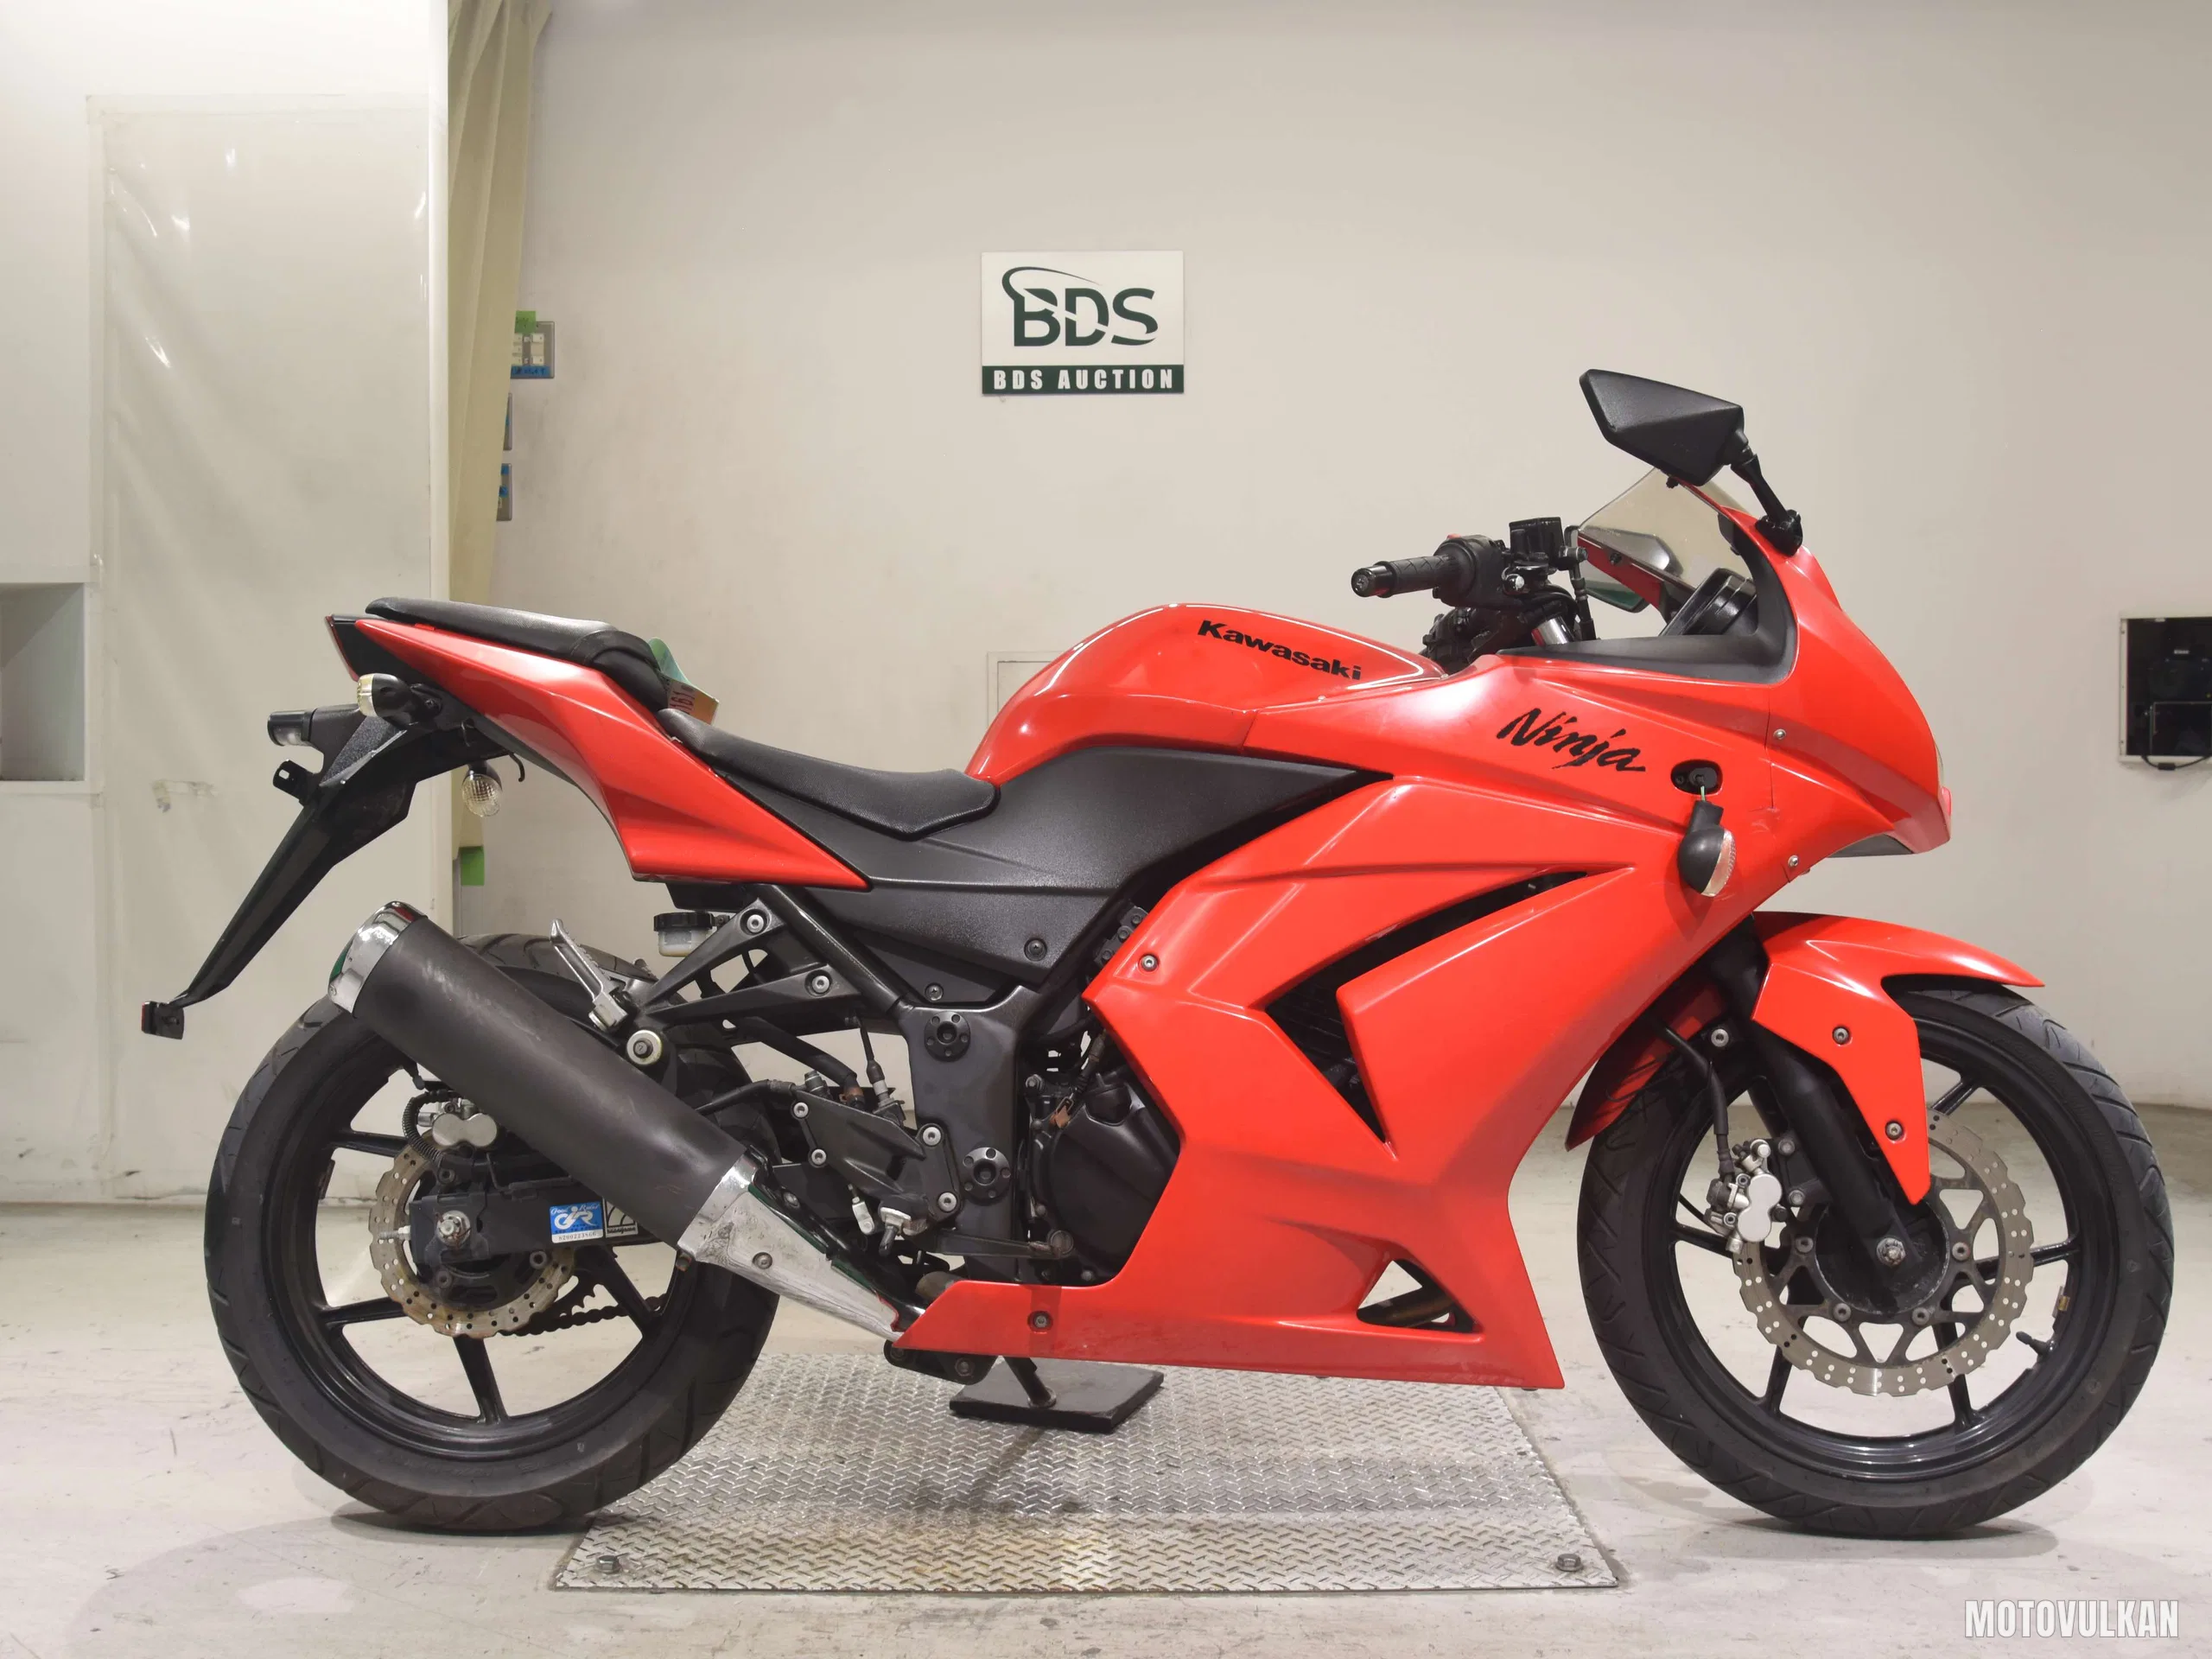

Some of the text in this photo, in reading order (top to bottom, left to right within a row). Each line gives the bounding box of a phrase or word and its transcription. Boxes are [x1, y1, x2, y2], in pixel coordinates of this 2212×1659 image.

[1001, 266, 1159, 346] BDS
[994, 369, 1173, 390] BDS AUCTION
[1198, 620, 1362, 681] Kawasaki
[1496, 708, 1646, 772] Ninja
